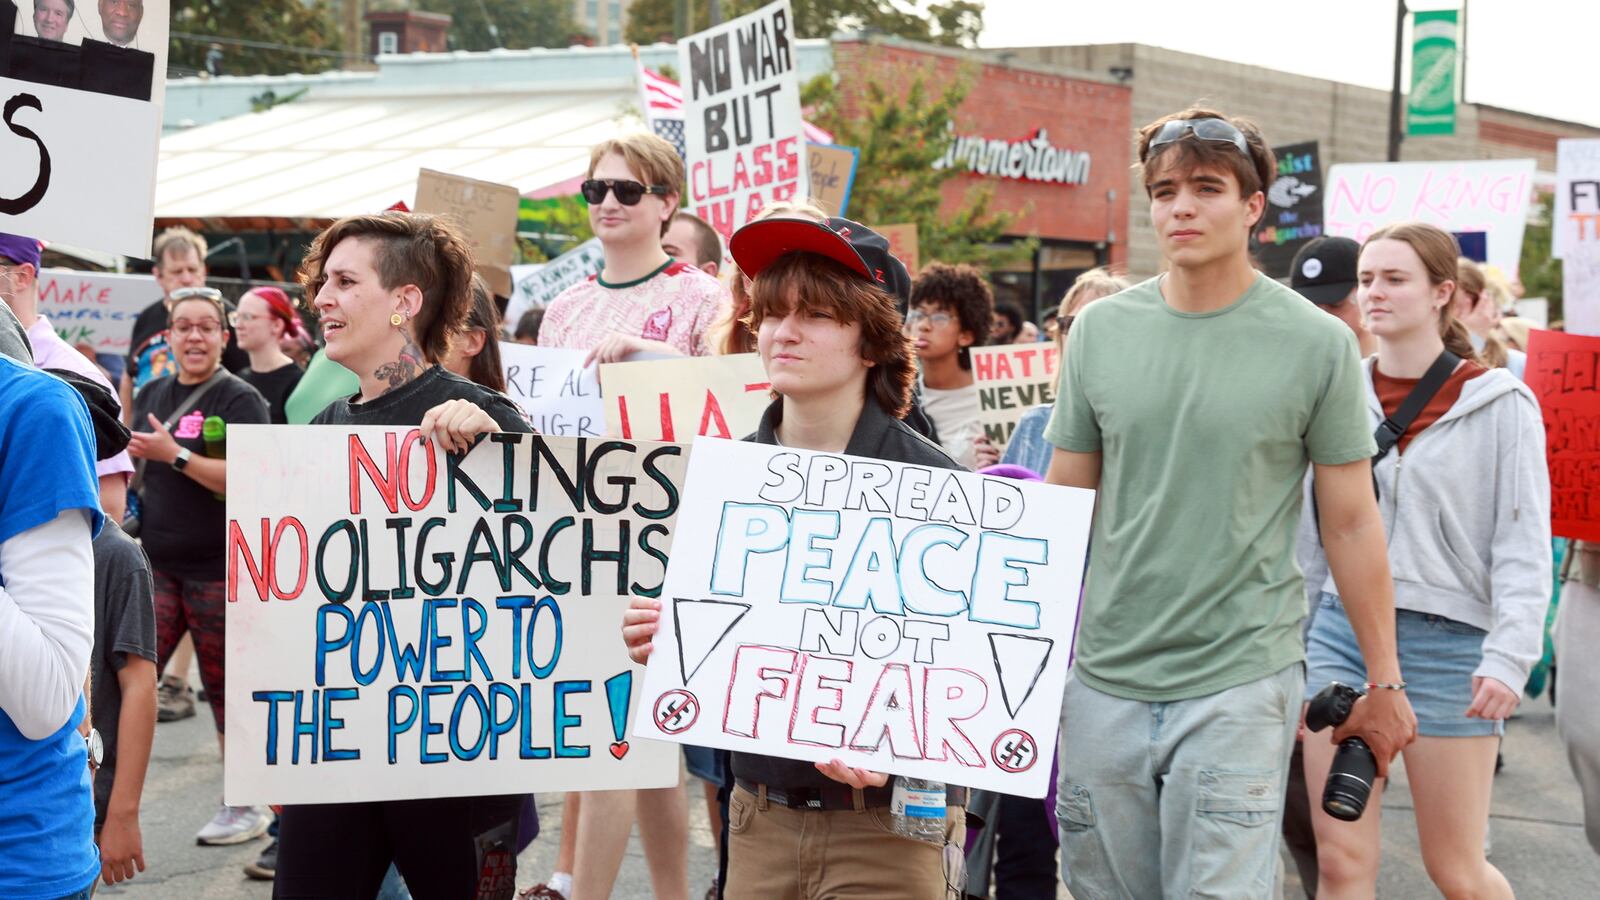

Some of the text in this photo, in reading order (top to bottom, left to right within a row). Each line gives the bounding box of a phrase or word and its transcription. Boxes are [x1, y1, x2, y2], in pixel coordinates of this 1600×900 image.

[689, 8, 791, 101] NO WAR
[703, 84, 781, 153] BUT
[692, 136, 798, 202] CLASS
[1330, 172, 1398, 216] NO
[38, 279, 113, 304] MAKE
[979, 382, 1056, 411] NEVE
[349, 428, 681, 519] NO KINGS
[758, 452, 1025, 530] SPREAD
[228, 514, 669, 603] NO OLIGARCHS
[710, 501, 1048, 629] PEACE
[316, 595, 563, 686] POWER TO
[800, 608, 949, 664] NOT
[252, 687, 360, 765] THE
[722, 642, 988, 768] FEAR
